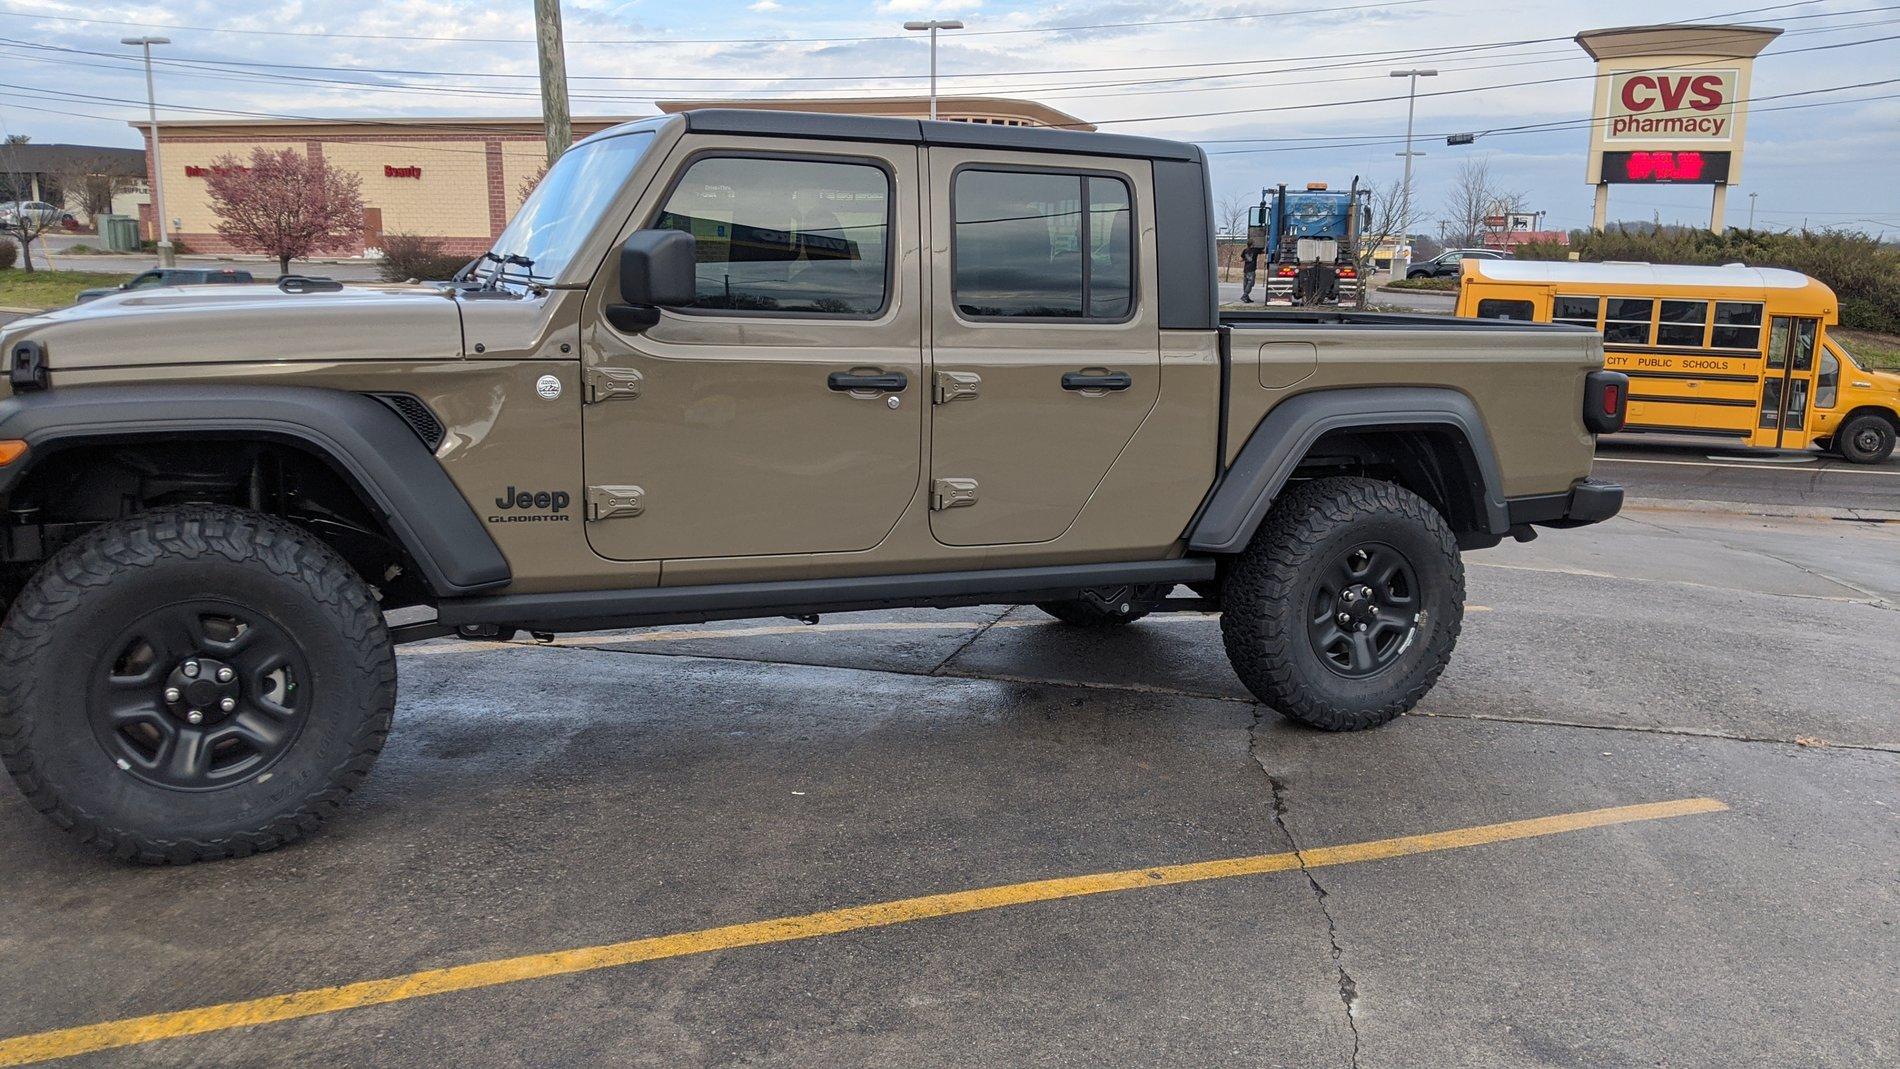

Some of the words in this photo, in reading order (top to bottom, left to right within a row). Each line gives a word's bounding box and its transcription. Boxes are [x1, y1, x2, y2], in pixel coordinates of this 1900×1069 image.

[1621, 75, 1723, 112] CVS
[1612, 114, 1725, 136] pharmacy
[384, 165, 421, 180] Beauty
[1607, 356, 1628, 366] CITY
[1638, 358, 1673, 368] PUBLIC
[1682, 360, 1729, 370] SCHOOLS
[495, 486, 570, 512] Jeep
[488, 515, 570, 523] GLADIATOR
